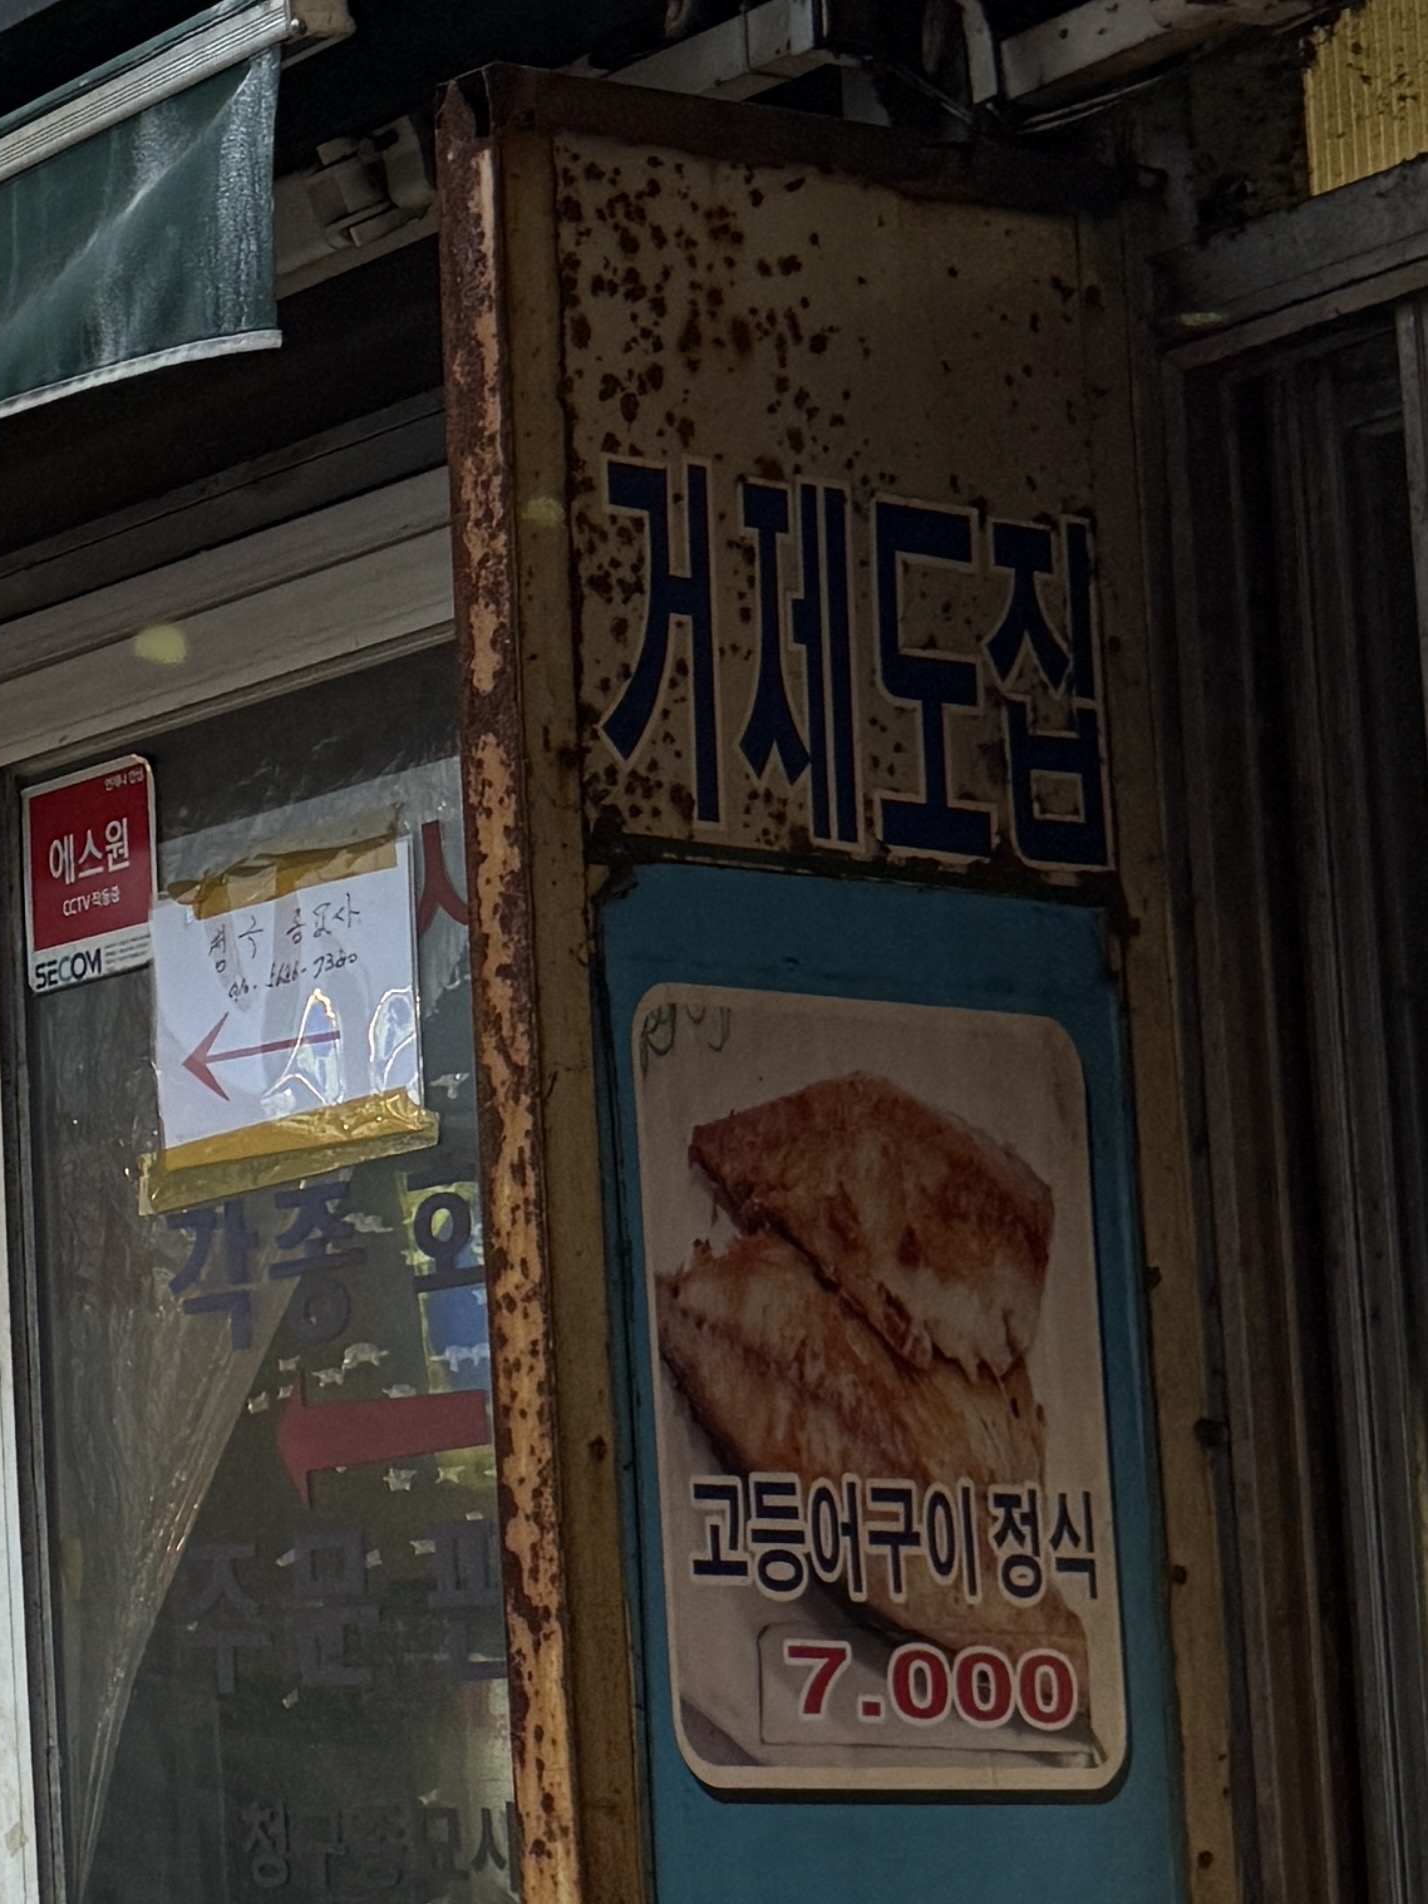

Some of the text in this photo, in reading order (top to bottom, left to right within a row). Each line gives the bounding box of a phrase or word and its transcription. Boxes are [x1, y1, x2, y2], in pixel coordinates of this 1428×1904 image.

[598, 452, 1115, 872] 거제도집
[48, 816, 131, 886] 에스원
[35, 948, 103, 990] SECOM
[690, 1472, 1100, 1606] 고등어구이 정식
[784, 1641, 1080, 1730] 7.000
